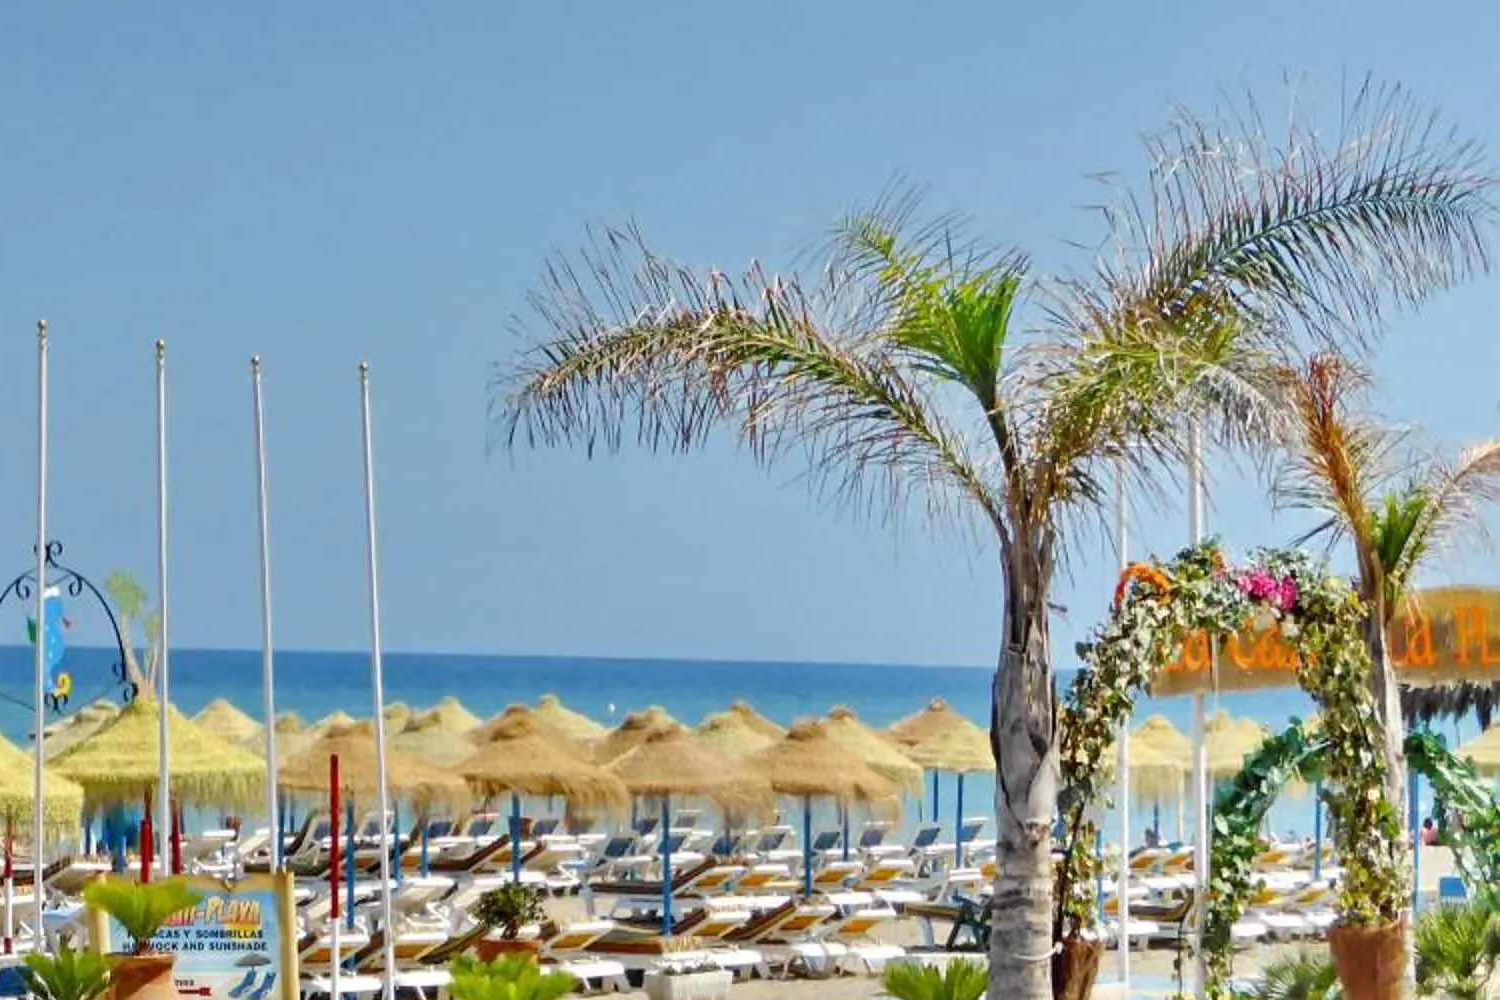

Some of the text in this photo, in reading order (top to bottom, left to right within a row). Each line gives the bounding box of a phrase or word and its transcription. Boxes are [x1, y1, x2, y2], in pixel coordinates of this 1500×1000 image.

[183, 929, 191, 939] Y
[195, 929, 264, 939] SOMBRILLAS
[182, 941, 205, 952] AND
[208, 941, 269, 952] SUNSHADE
